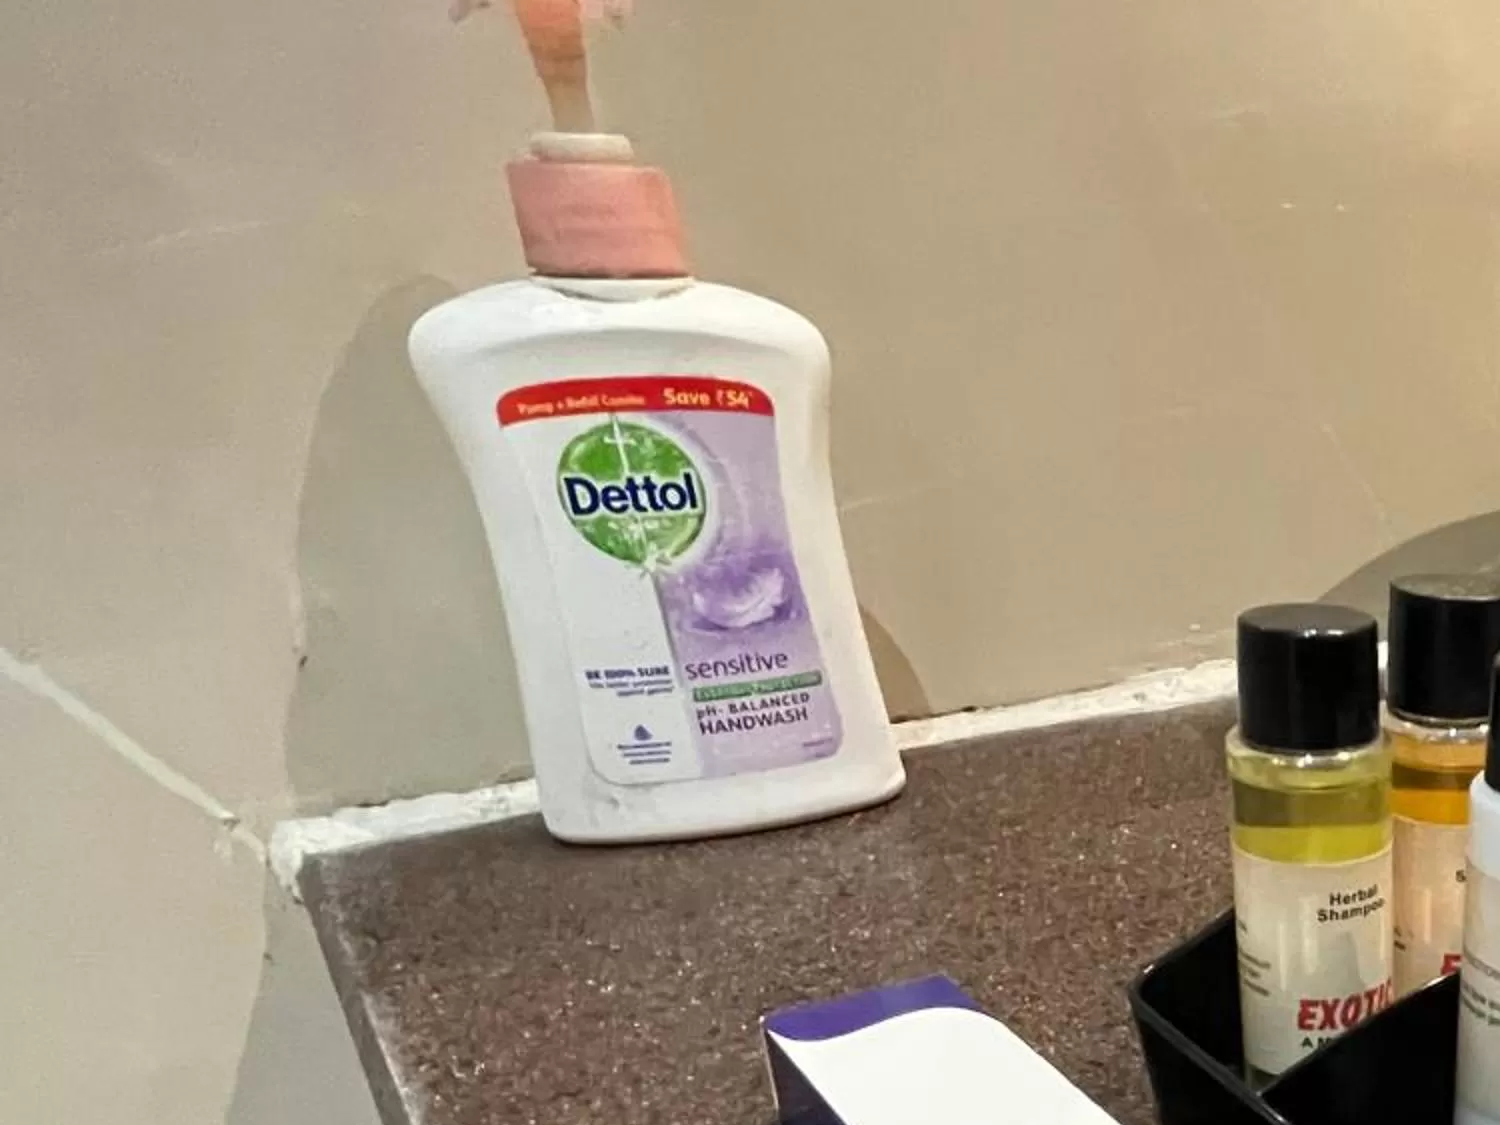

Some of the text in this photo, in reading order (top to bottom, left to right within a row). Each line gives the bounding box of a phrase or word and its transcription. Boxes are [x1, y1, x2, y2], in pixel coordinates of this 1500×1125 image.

[663, 388, 710, 406] Save
[563, 472, 698, 516] Dettol
[685, 651, 789, 680] sensitive
[728, 692, 811, 715] BALANCED
[698, 707, 810, 736] HANDWASH
[1329, 884, 1378, 906] Herbal
